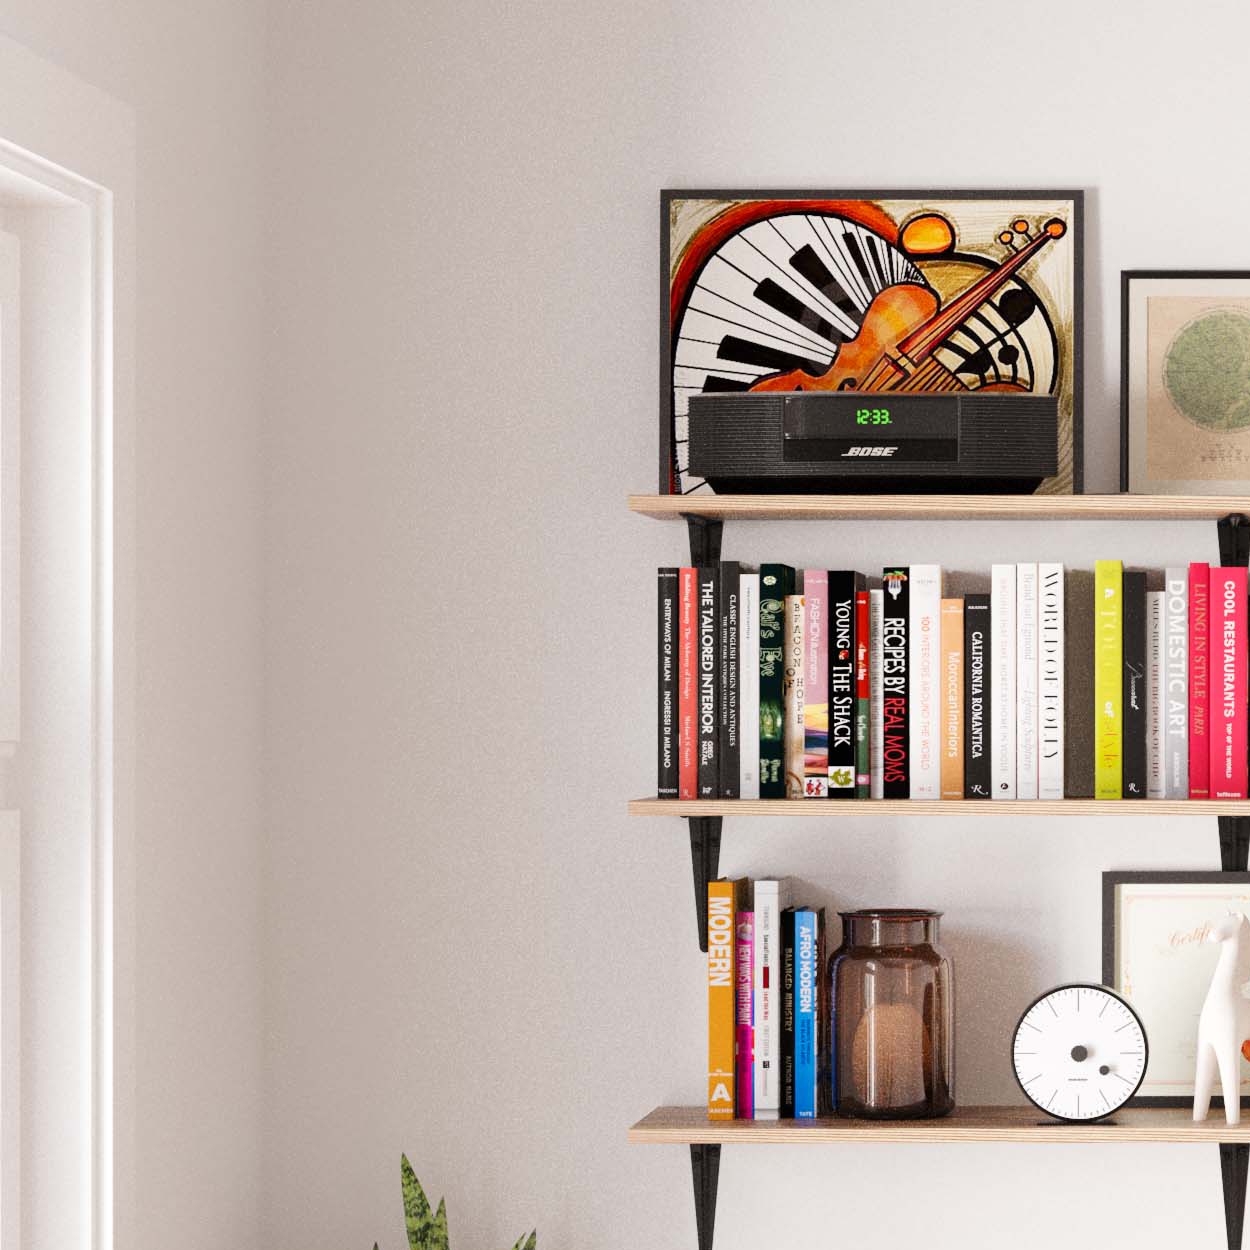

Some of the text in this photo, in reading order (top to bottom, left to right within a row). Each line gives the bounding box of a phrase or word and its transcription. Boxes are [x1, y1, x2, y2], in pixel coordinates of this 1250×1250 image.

[841, 446, 898, 457] BOSE
[663, 598, 671, 768] ENTRYWAYS OF MILAN INGRESSI DI MILANO
[701, 581, 714, 734] THE TAILORED INTERIOR
[728, 594, 737, 747] CLASSIC ENGLISH DESIGN AND ANTIQUES
[833, 599, 852, 748] YOUNG THE SHACK
[921, 616, 930, 770] 100 INTERIORS AROUND THE WORLD
[1169, 579, 1186, 739] DOMESTIC ART
[1194, 583, 1206, 736] LIVING IN STYLE PARIS
[1223, 580, 1236, 718] COOL RESTAURANTS
[883, 617, 905, 782] RECIPES BY REAL MOMS
[971, 631, 983, 759] CALIFORNIA ROMANTICA
[1104, 701, 1114, 718] of
[1225, 735, 1232, 744] OF
[709, 896, 732, 986] MODERN
[739, 944, 751, 960] NEW
[739, 961, 751, 982] WAYS
[784, 948, 793, 989] BALANCED
[799, 926, 811, 1013] AFRO MODERN
[739, 983, 751, 1004] WITH
[739, 1004, 751, 1026] PAINT
[784, 992, 793, 1032] MINISTRY
